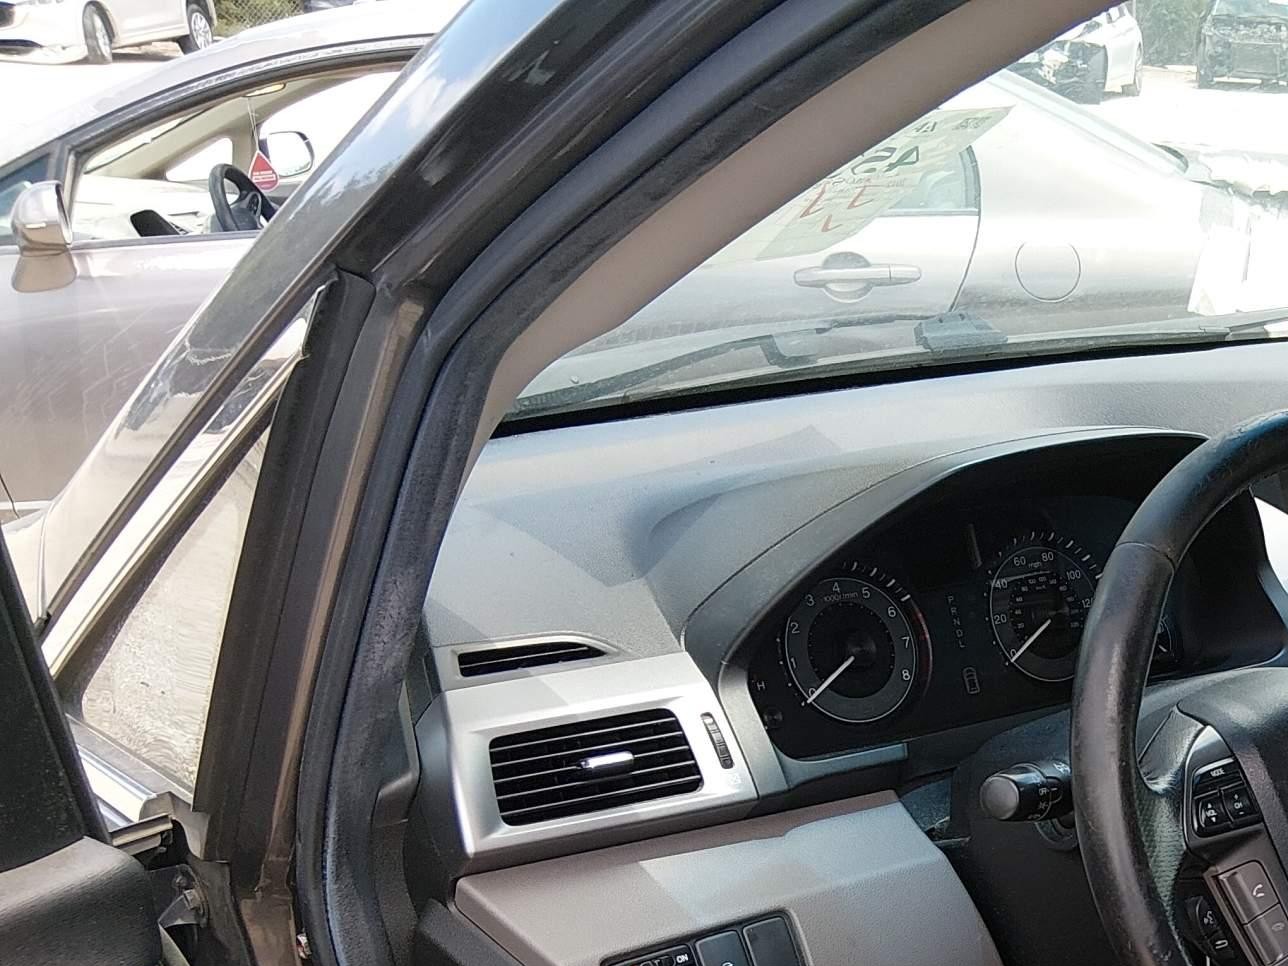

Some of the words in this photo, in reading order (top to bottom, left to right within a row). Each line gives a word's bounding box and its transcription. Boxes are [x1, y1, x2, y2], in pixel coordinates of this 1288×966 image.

[1013, 556, 1026, 567] 60
[1040, 551, 1054, 562] 80
[1066, 569, 1081, 580] 100
[832, 582, 841, 594] 4
[995, 578, 1008, 589] 40
[861, 587, 871, 599] 5
[805, 594, 815, 607] 3
[1082, 597, 1094, 609] 12
[887, 607, 897, 618] 6
[993, 613, 1007, 625] 20
[790, 622, 800, 634] 2
[901, 636, 911, 649] 7
[791, 656, 797, 669] 1
[901, 669, 911, 681] 8
[756, 680, 766, 691] H
[676, 953, 689, 963] ON
